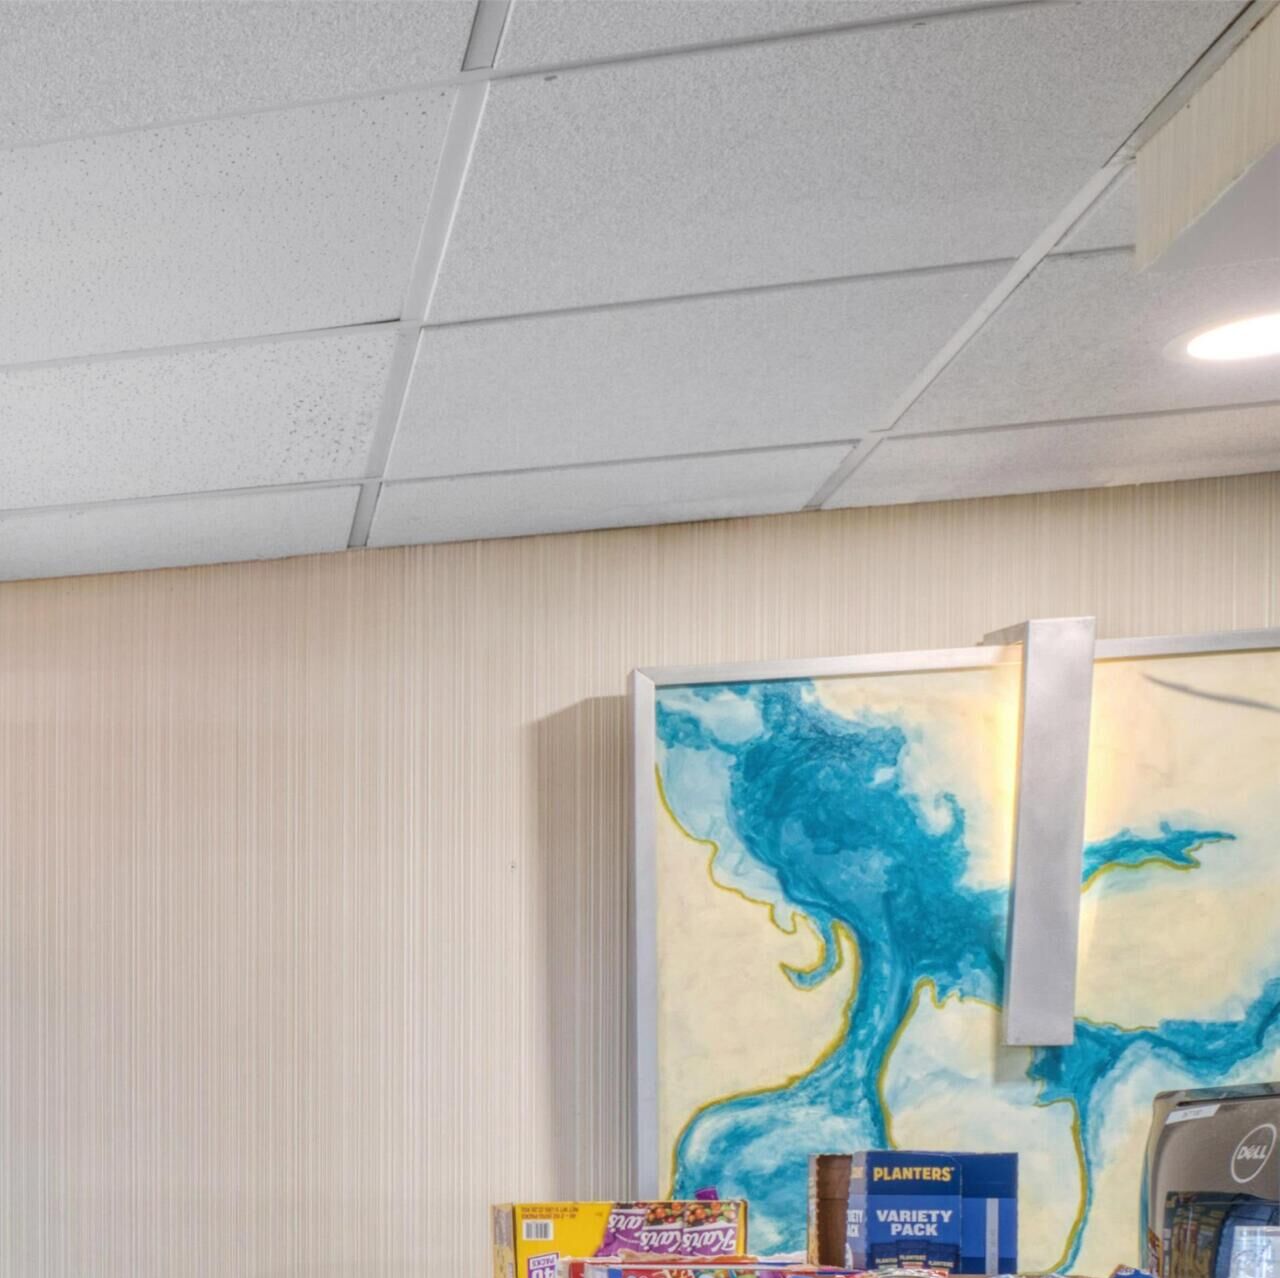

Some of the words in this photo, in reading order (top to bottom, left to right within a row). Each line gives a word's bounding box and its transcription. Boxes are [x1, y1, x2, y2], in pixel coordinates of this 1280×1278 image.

[873, 1166, 952, 1182] PLANTERS
[608, 1212, 646, 1231] ar's
[876, 1210, 953, 1223] VARIETY
[890, 1223, 938, 1236] PACK
